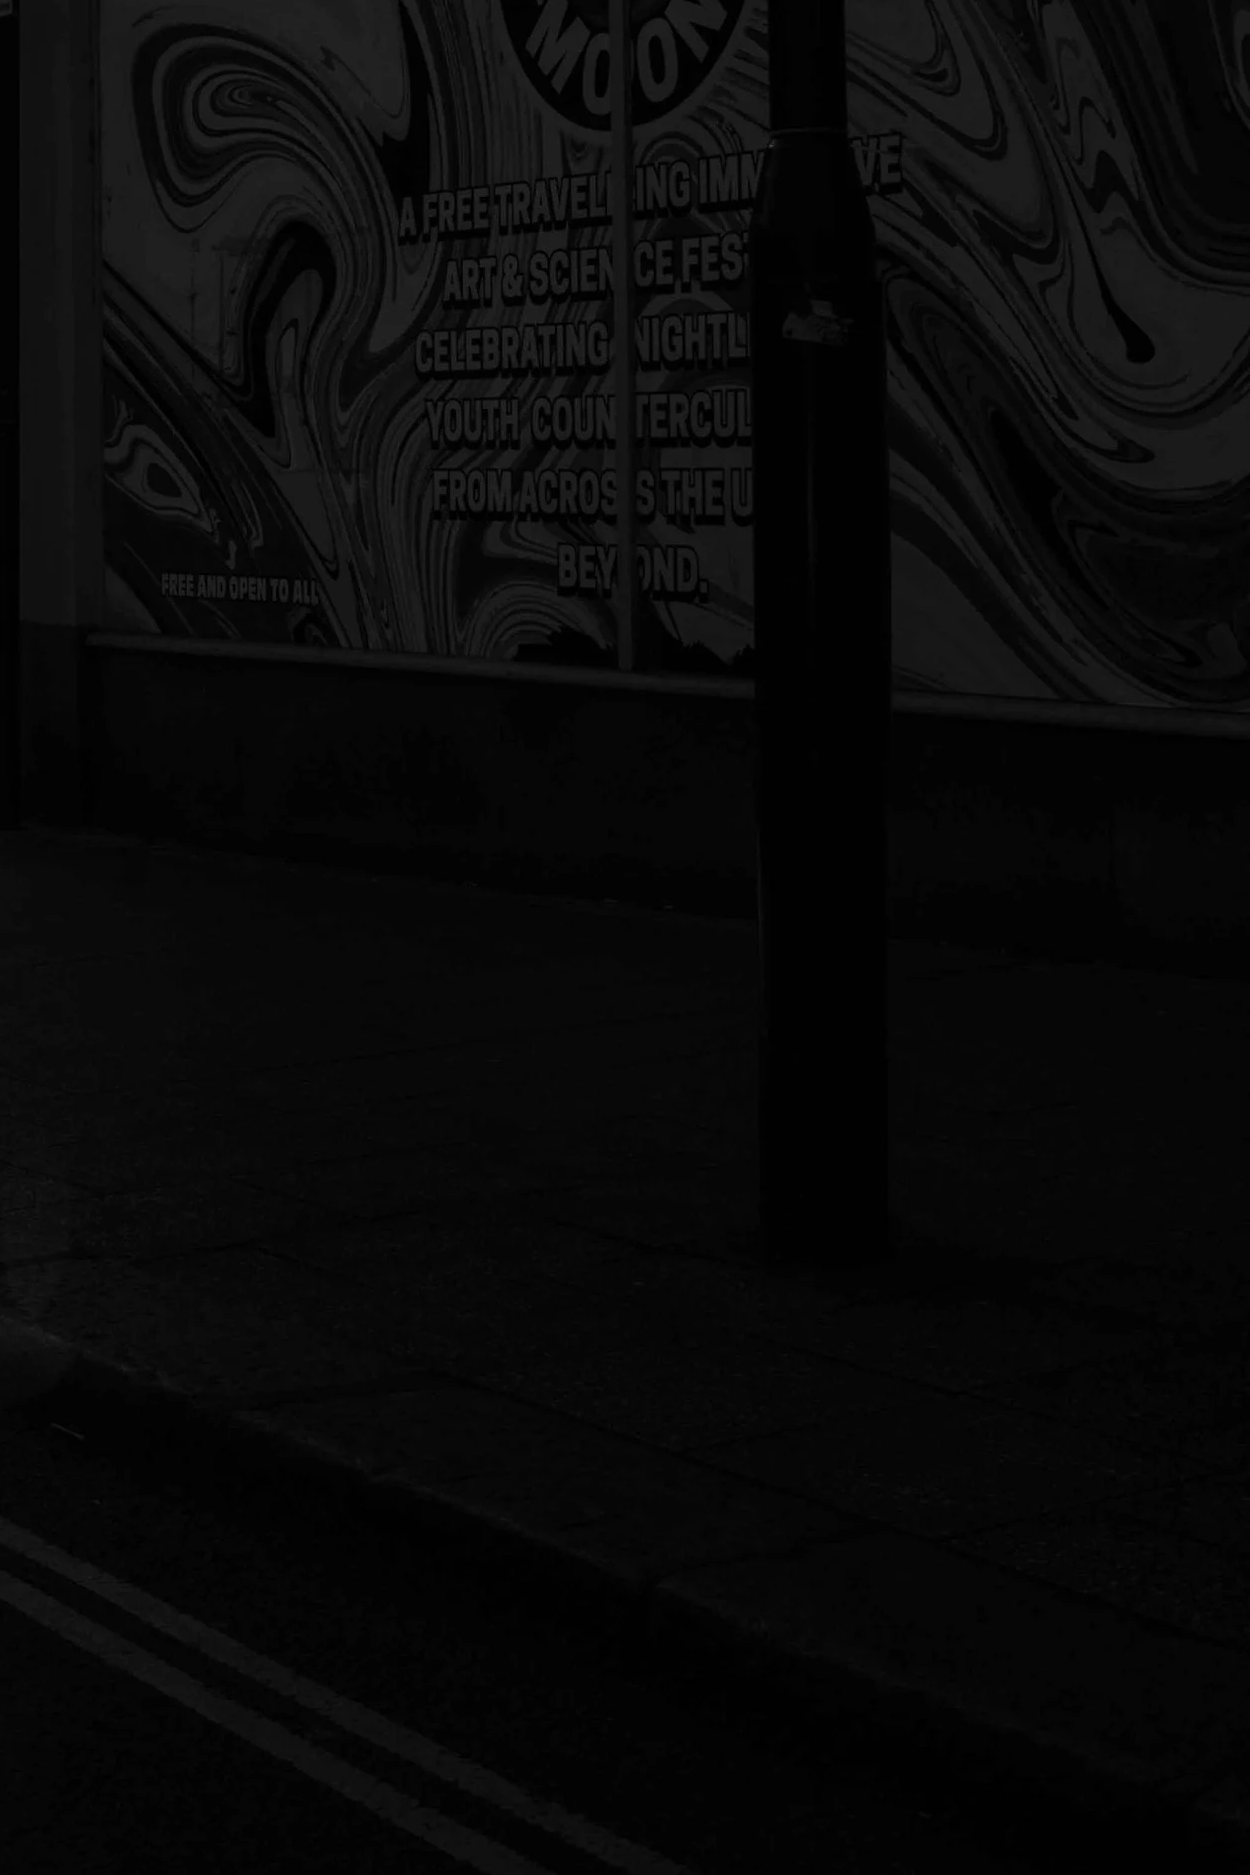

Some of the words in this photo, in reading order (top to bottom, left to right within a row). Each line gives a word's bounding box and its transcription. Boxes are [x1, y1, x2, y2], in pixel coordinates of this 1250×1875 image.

[399, 194, 418, 244] A
[422, 187, 491, 241] FREE
[442, 255, 497, 309] ART
[501, 252, 525, 307] &
[529, 236, 675, 305] SCIENCE
[414, 320, 611, 381] CELEBRATING
[634, 312, 751, 371] NIGHTL
[424, 396, 519, 450] YOUTH
[531, 388, 752, 450] COUNTERCUL
[431, 468, 515, 521] FROM
[517, 468, 656, 524] ACROSS
[660, 468, 726, 526] THE
[729, 468, 754, 525] U
[161, 572, 195, 598] FREE
[197, 574, 227, 599] AND
[229, 575, 267, 602] OPEN
[269, 577, 289, 603] TO
[292, 578, 319, 605] ALL
